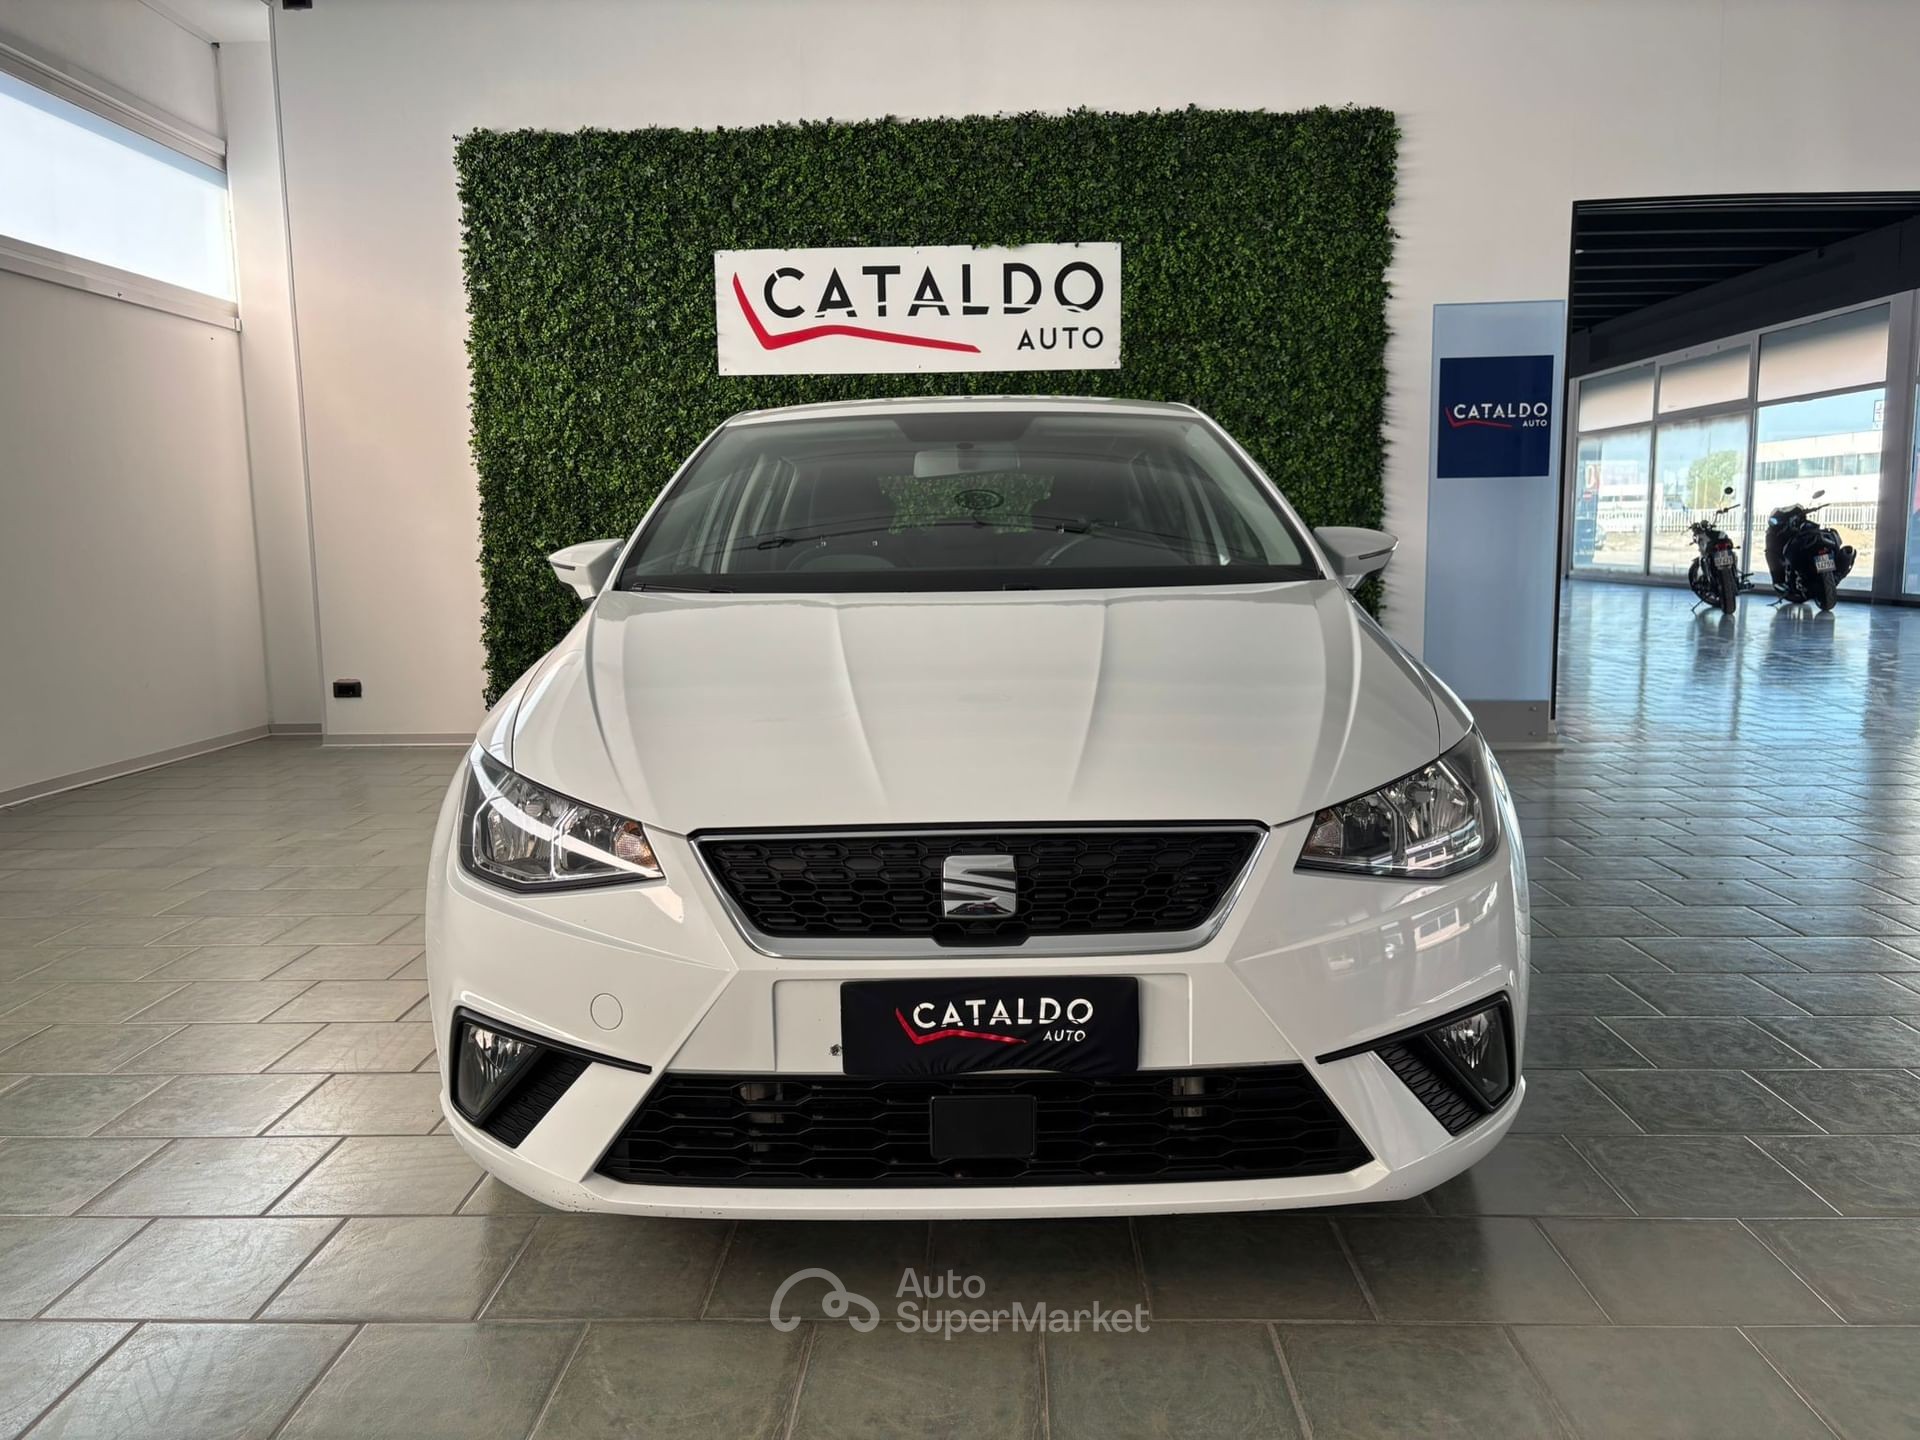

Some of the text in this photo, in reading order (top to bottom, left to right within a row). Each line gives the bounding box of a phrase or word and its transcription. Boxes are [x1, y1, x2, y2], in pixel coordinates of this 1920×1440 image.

[763, 261, 1104, 319] CATALDO
[1017, 326, 1104, 351] AUTO
[1453, 402, 1548, 419] CATALDO
[1522, 419, 1548, 427] AUTO
[912, 997, 1094, 1029] CATALDO
[1043, 1029, 1086, 1042] AUTO
